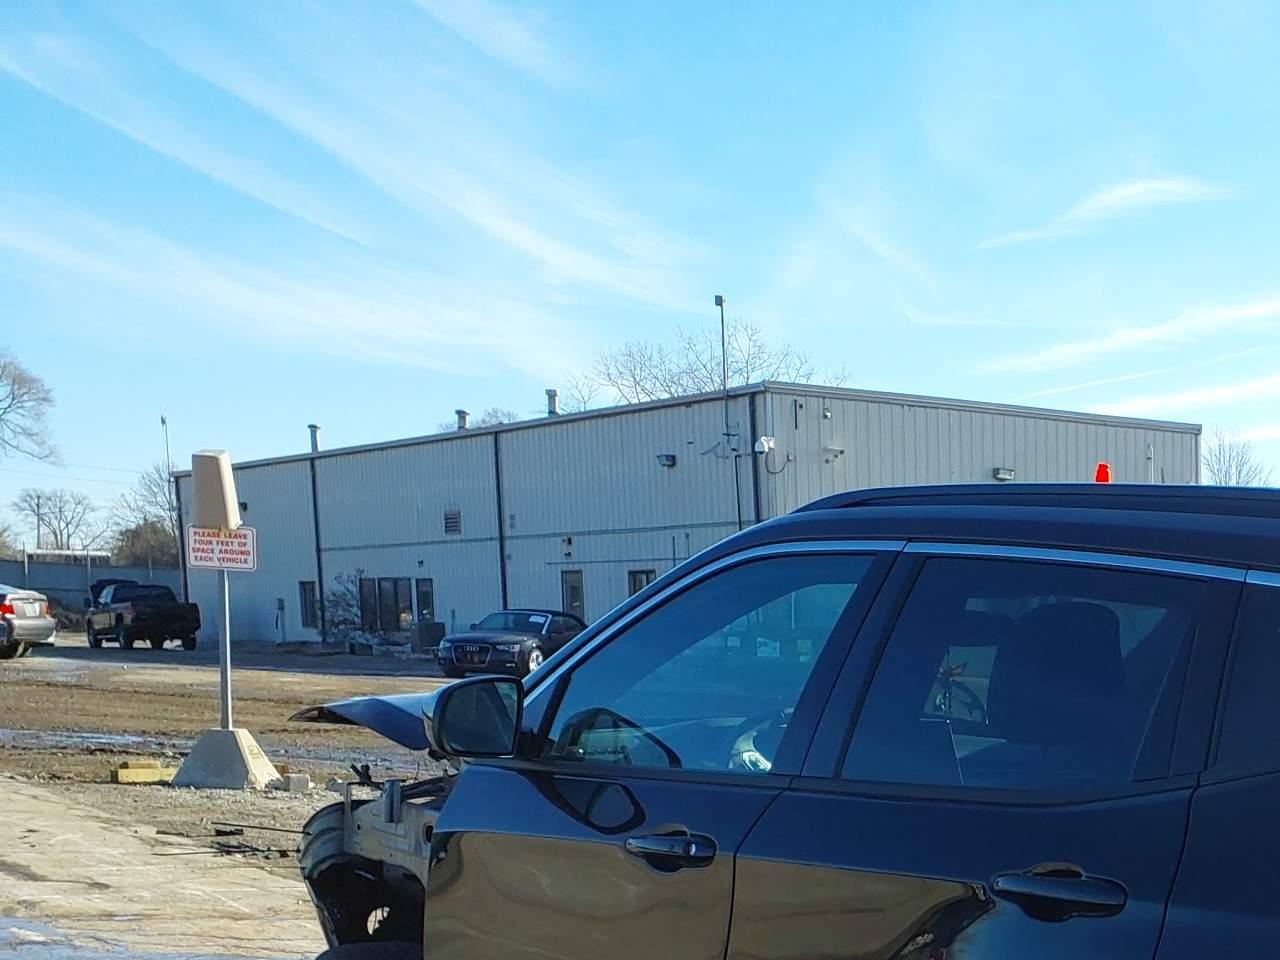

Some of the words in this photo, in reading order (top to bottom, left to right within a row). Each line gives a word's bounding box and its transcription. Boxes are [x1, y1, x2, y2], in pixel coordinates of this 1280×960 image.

[224, 532, 248, 540] LEAVE
[219, 548, 251, 556] AROUND
[217, 556, 249, 564] VEHICLE
